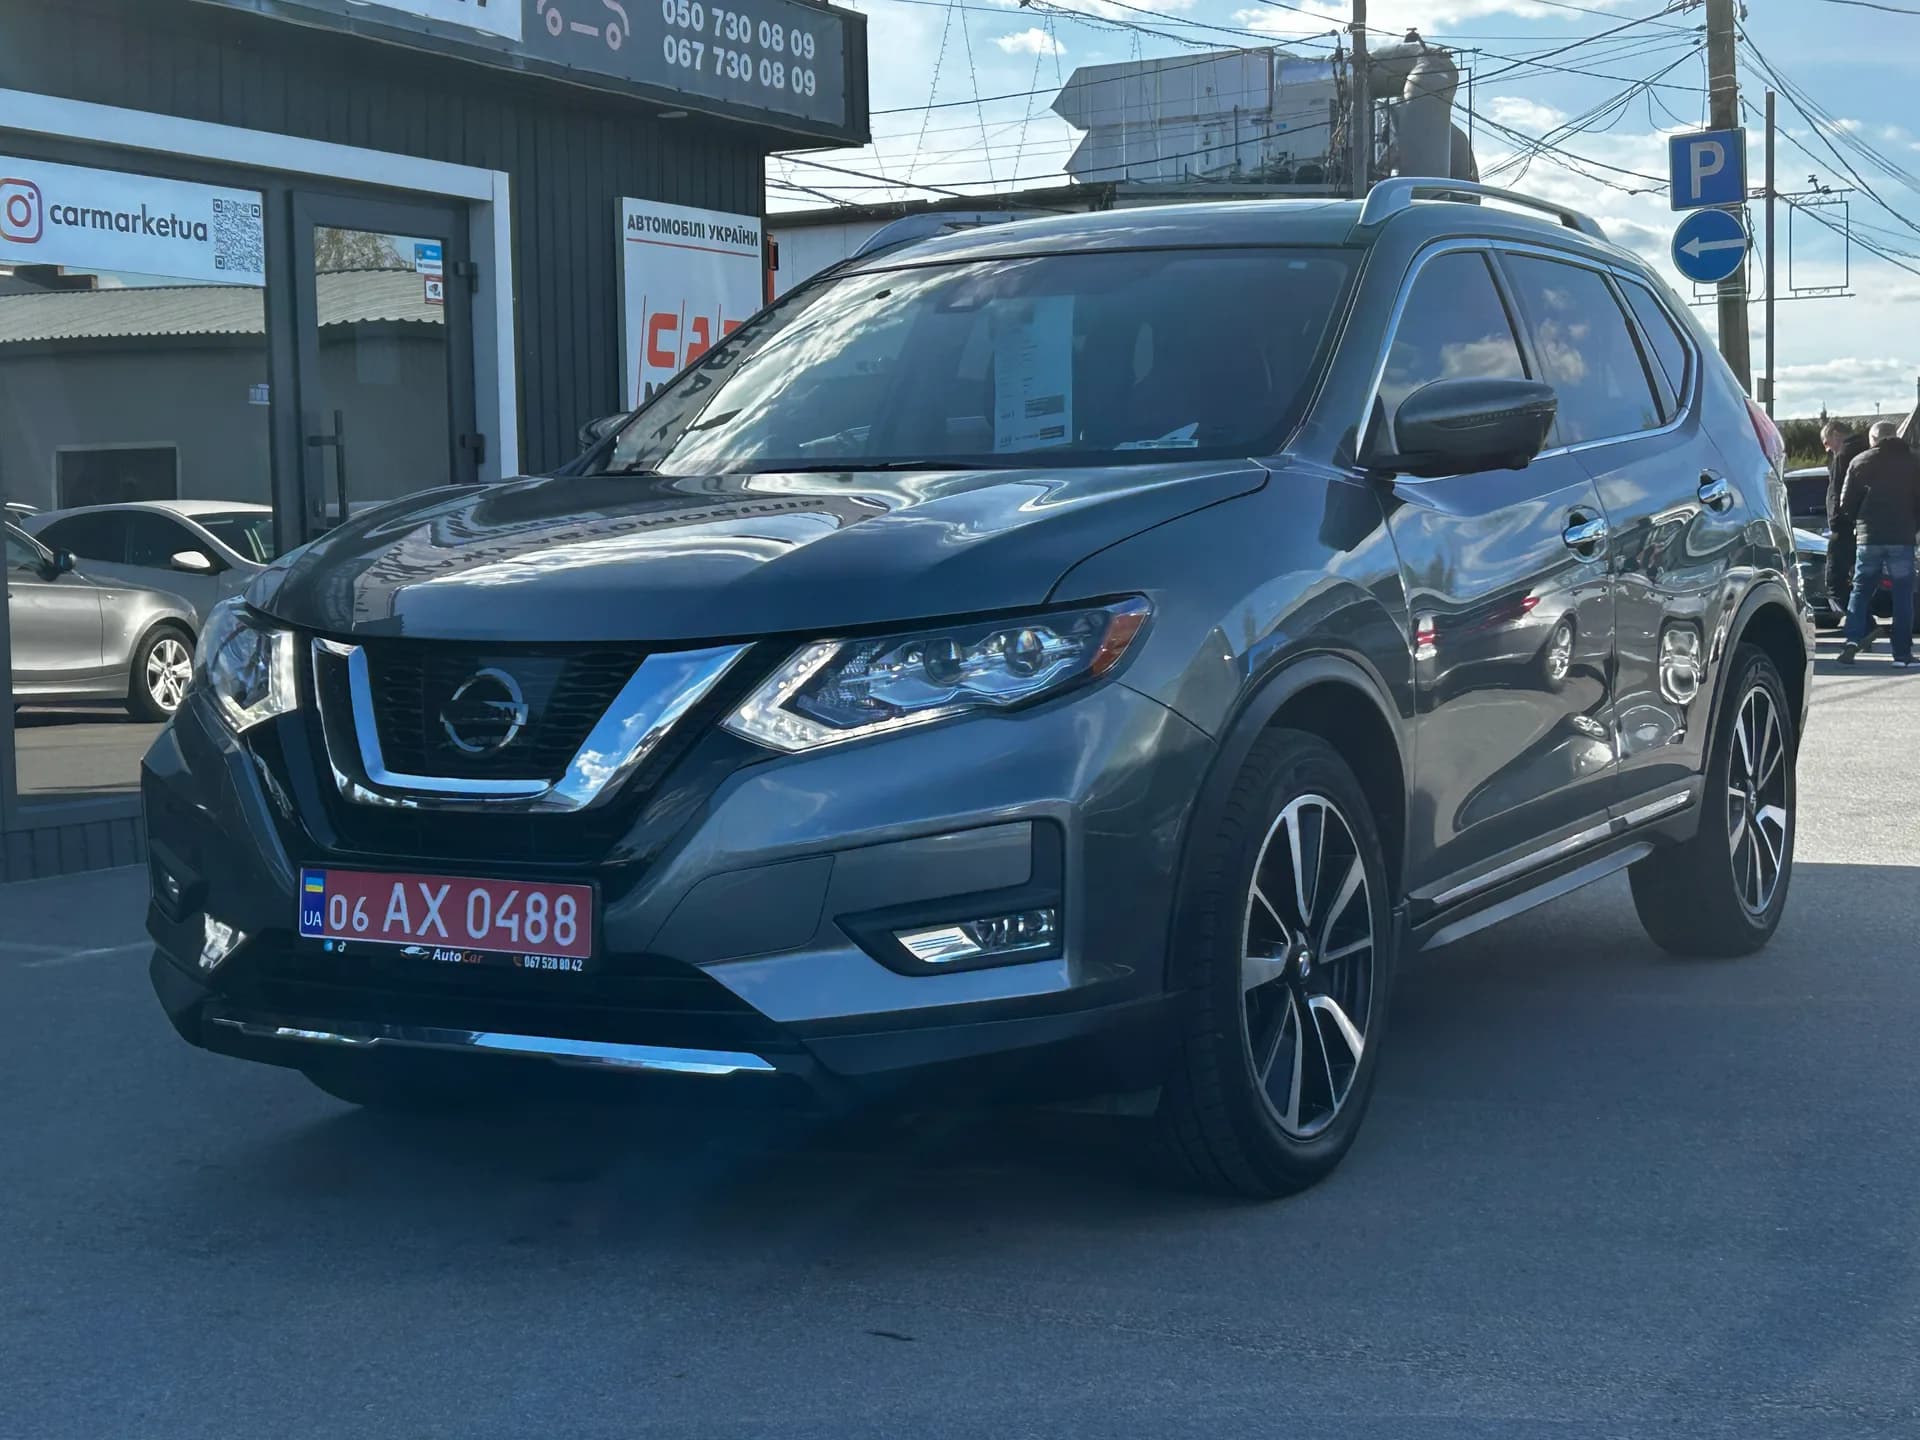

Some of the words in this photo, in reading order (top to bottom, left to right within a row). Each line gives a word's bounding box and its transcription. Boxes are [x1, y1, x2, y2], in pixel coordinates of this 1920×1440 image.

[662, 0, 704, 31] 050
[712, 8, 751, 43] 730
[759, 20, 784, 52] 08
[790, 29, 815, 60] 09
[663, 34, 704, 70] 067
[713, 46, 752, 82] 730
[759, 58, 785, 89] 08
[791, 66, 816, 96] 09
[1690, 141, 1725, 200] P
[49, 203, 208, 242] carmarketua
[627, 213, 705, 239] АВТОМОБІЛІ
[708, 224, 758, 247] УКРАЇНИ
[647, 313, 744, 369] CA
[304, 910, 322, 927] UA
[329, 894, 369, 932] 06
[382, 882, 451, 938] AX
[466, 887, 577, 947] 0488
[432, 949, 484, 964] AutoCar
[524, 955, 540, 969] 067
[571, 959, 583, 972] 42
